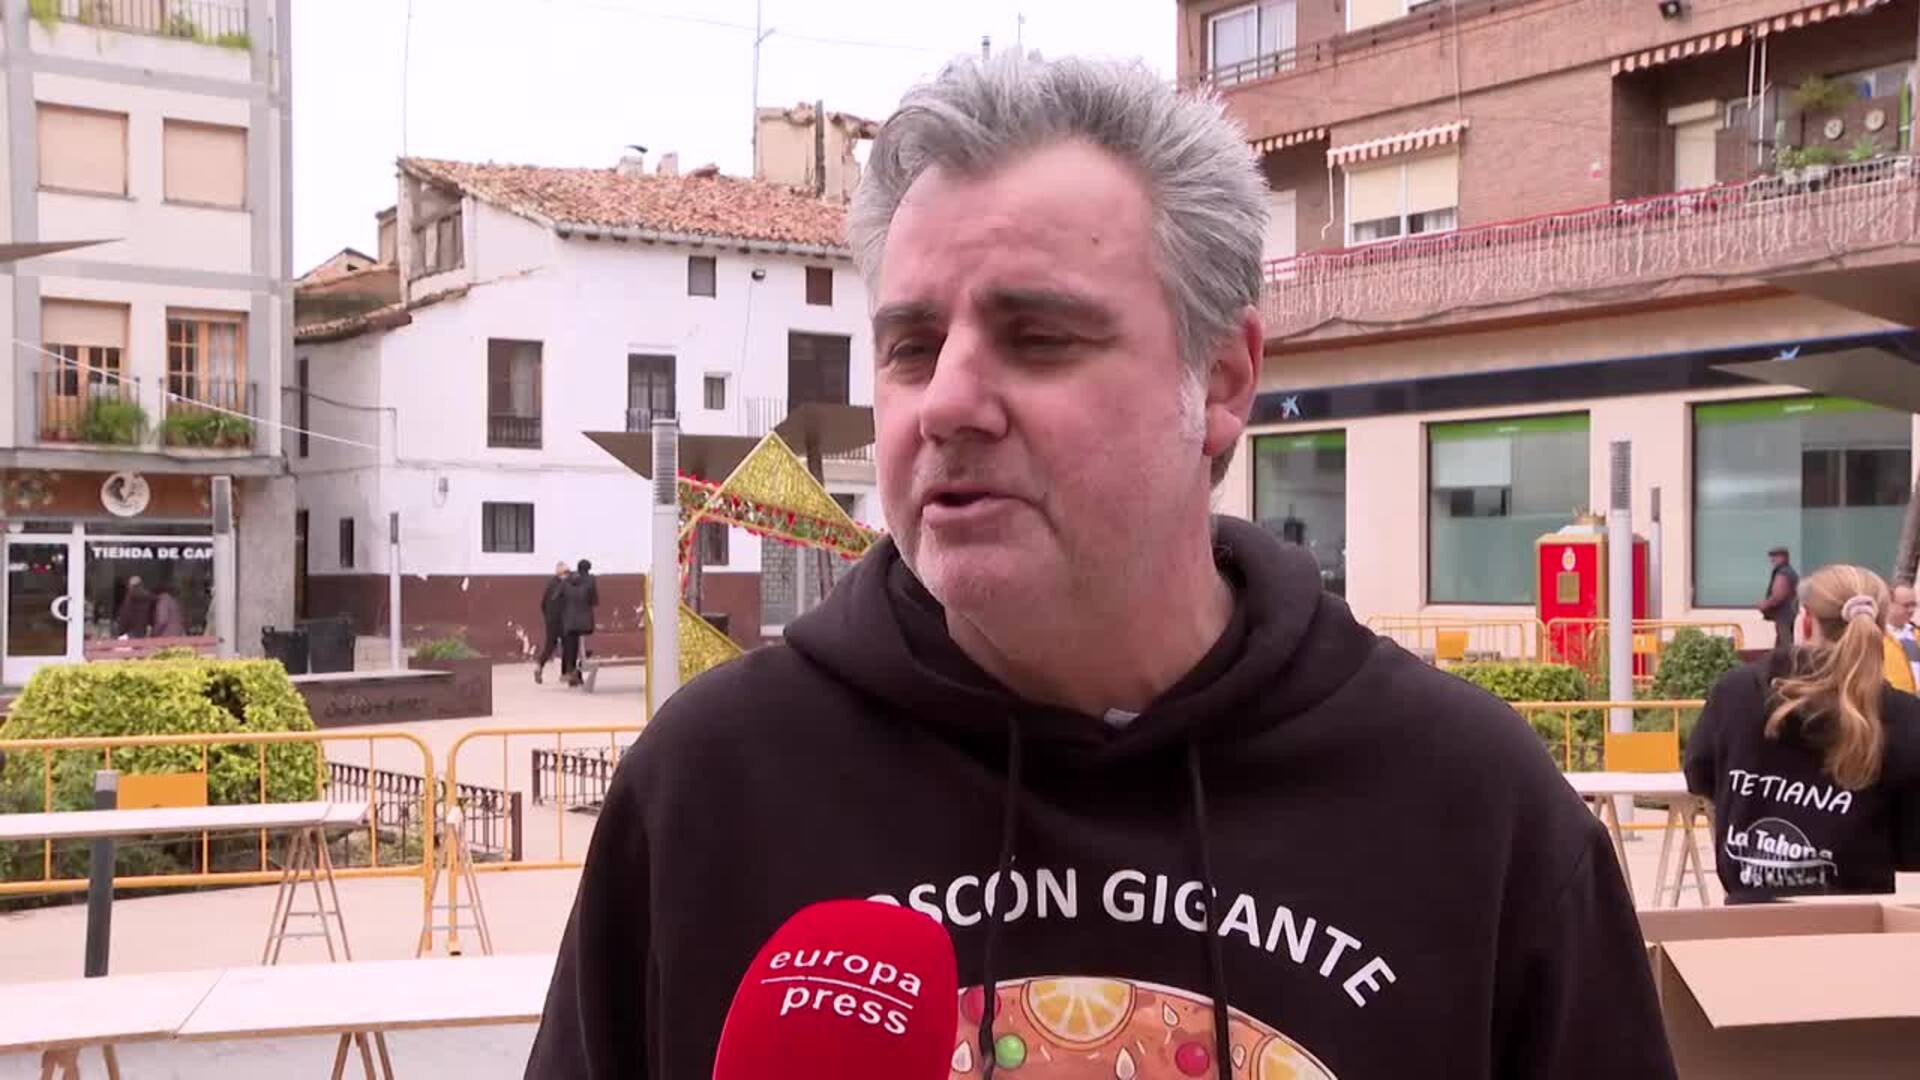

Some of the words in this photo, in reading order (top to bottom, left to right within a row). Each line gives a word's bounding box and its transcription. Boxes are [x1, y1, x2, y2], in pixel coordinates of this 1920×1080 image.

[92, 546, 153, 559] TIENDA
[157, 546, 180, 559] DE
[1728, 769, 1853, 814] TETIANA
[1726, 824, 1749, 847] La
[865, 855, 1078, 927] SCÓN
[1102, 869, 1397, 1008] GIGANTE
[769, 949, 922, 997] europa
[780, 986, 909, 1035] press
